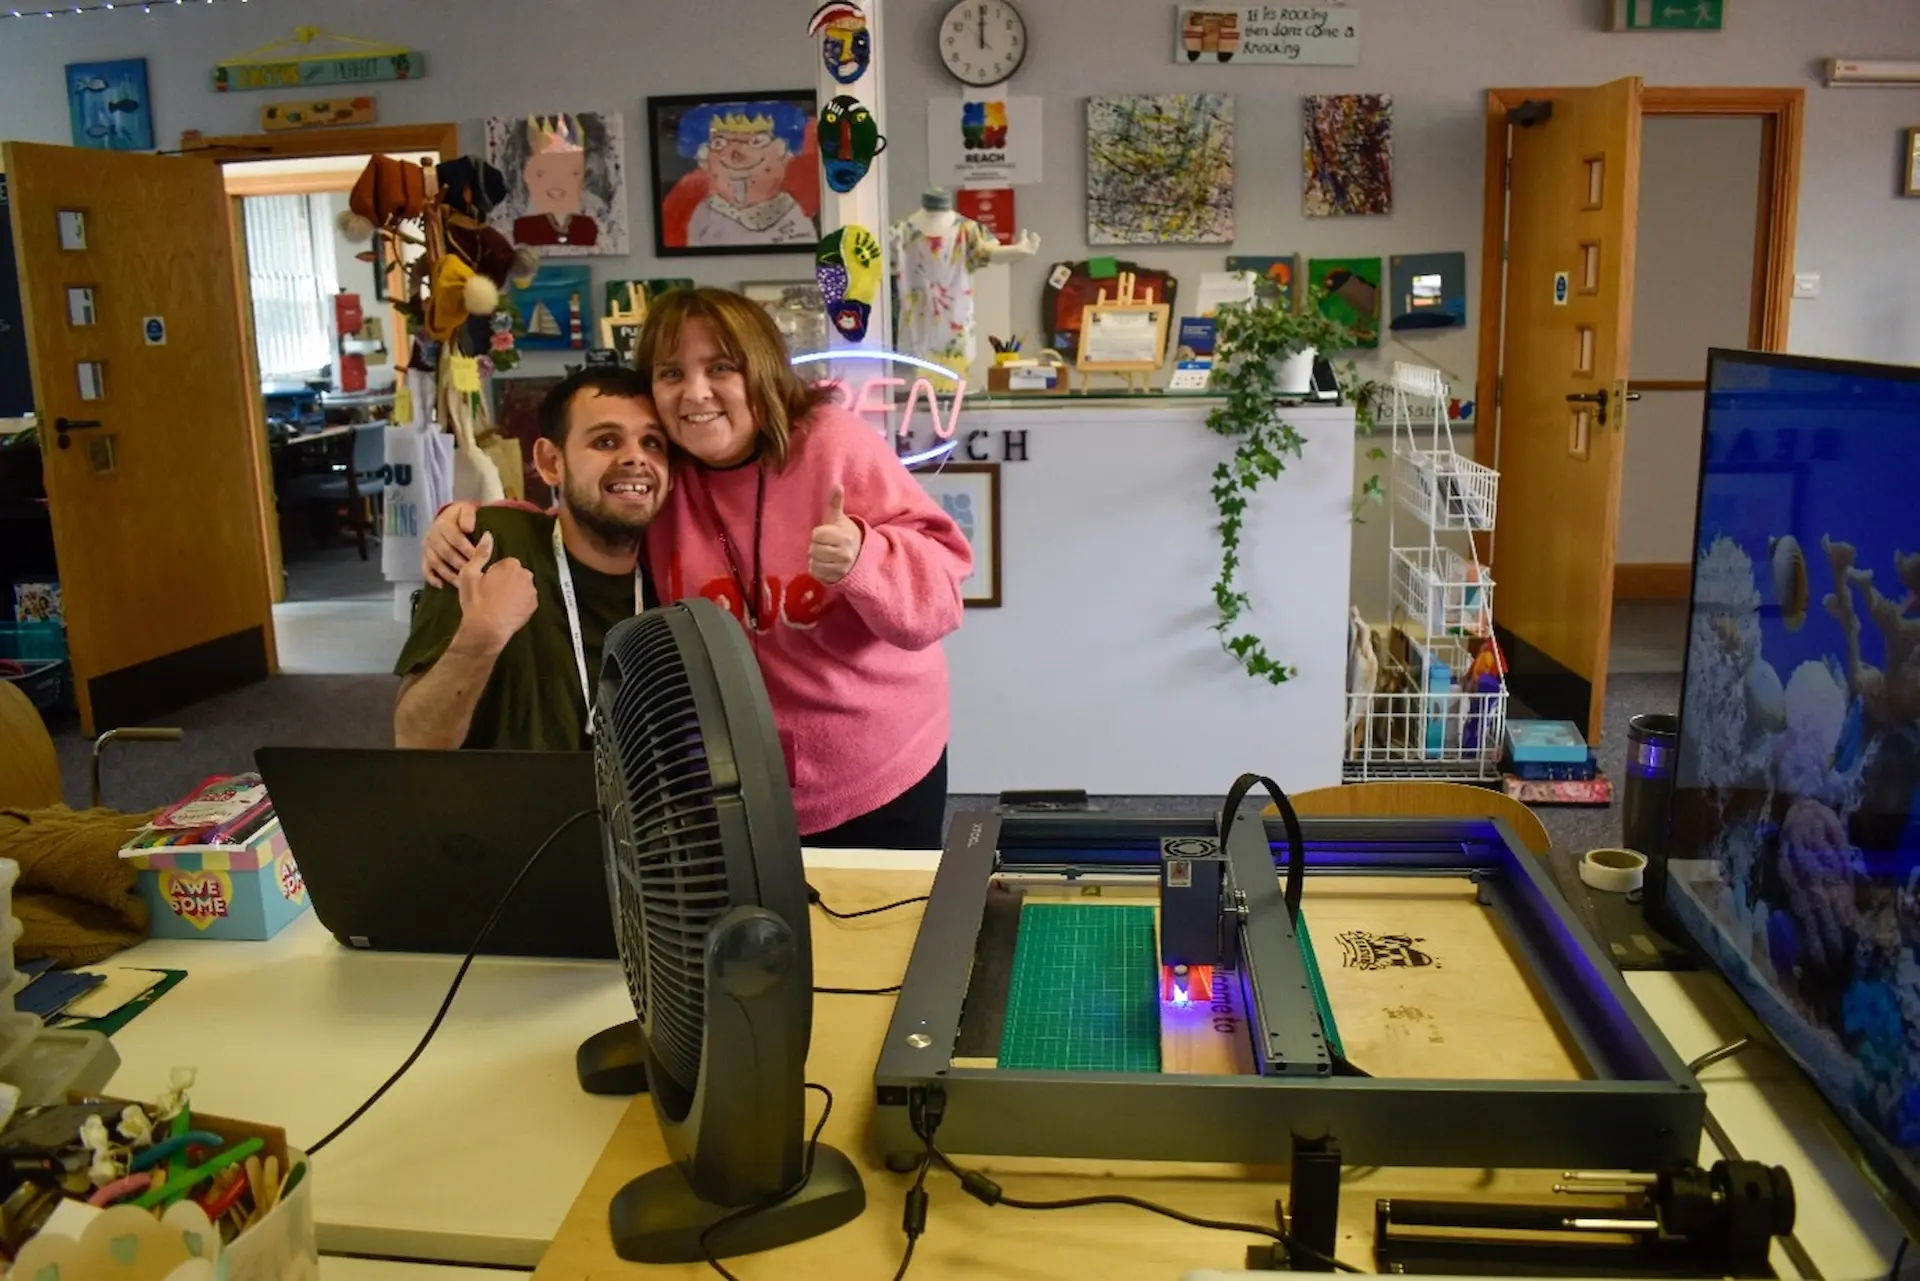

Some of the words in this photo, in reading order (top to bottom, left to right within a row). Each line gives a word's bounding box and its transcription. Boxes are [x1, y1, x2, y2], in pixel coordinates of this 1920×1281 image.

[965, 153, 1005, 163] REACH
[171, 879, 219, 898] AWE
[171, 897, 228, 916] SOME
